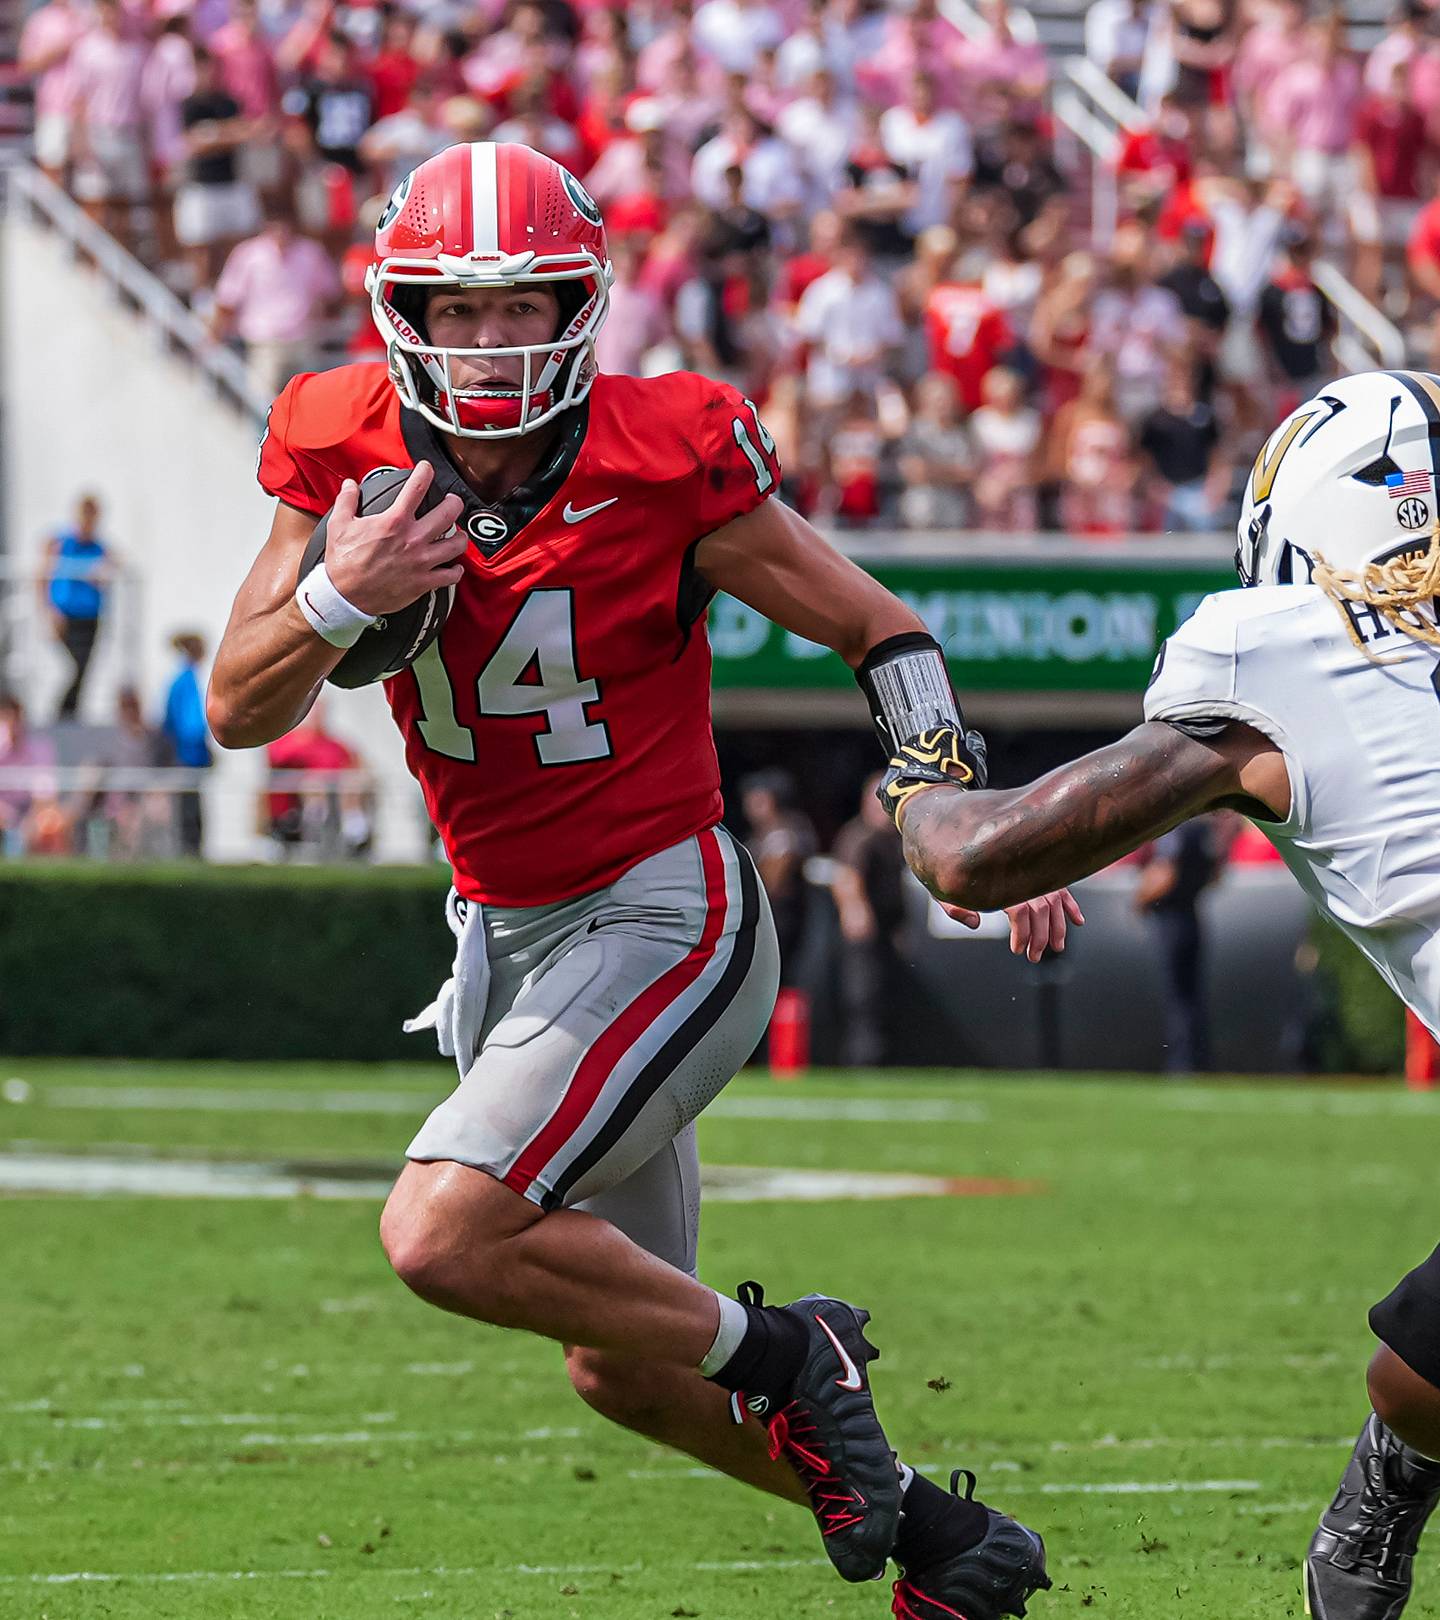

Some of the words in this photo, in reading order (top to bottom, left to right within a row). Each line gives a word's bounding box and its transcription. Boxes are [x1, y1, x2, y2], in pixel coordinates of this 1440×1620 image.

[470, 514, 507, 540] G
[1397, 498, 1428, 529] SEC
[411, 586, 614, 767] 14
